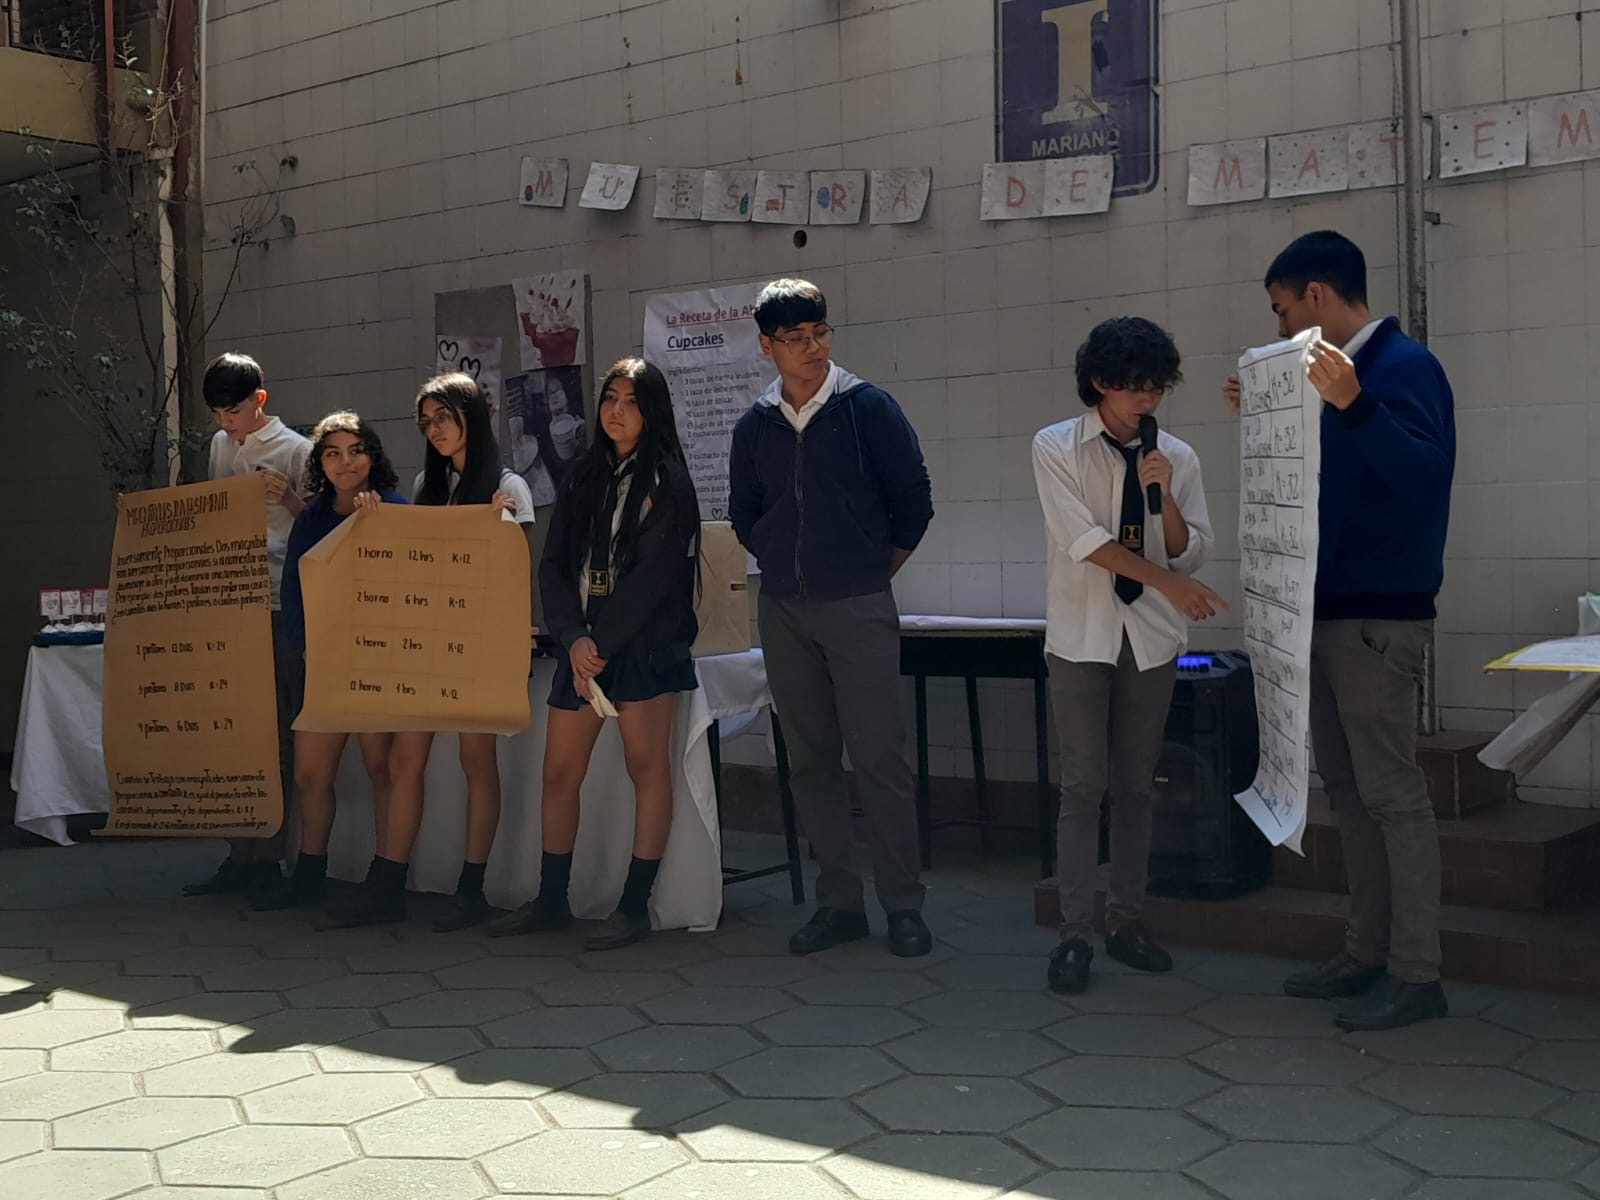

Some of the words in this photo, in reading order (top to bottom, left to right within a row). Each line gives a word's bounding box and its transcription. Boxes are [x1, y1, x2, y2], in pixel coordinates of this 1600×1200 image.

[1031, 128, 1121, 158] MARIANO
[667, 314, 677, 325] La
[680, 310, 712, 323] Receta
[714, 308, 728, 320] de
[730, 306, 739, 317] la
[667, 332, 725, 350] Cupcakes
[363, 547, 393, 559] horno
[408, 549, 419, 562] 12
[419, 550, 434, 563] hrs
[357, 591, 362, 602] 2
[363, 591, 389, 603] horno
[404, 594, 411, 605] 6
[413, 594, 429, 607] hrs
[363, 635, 387, 648] horno
[402, 638, 408, 649] 2
[409, 638, 424, 650] hrs
[359, 679, 382, 693] horno
[402, 683, 416, 695] hrs
